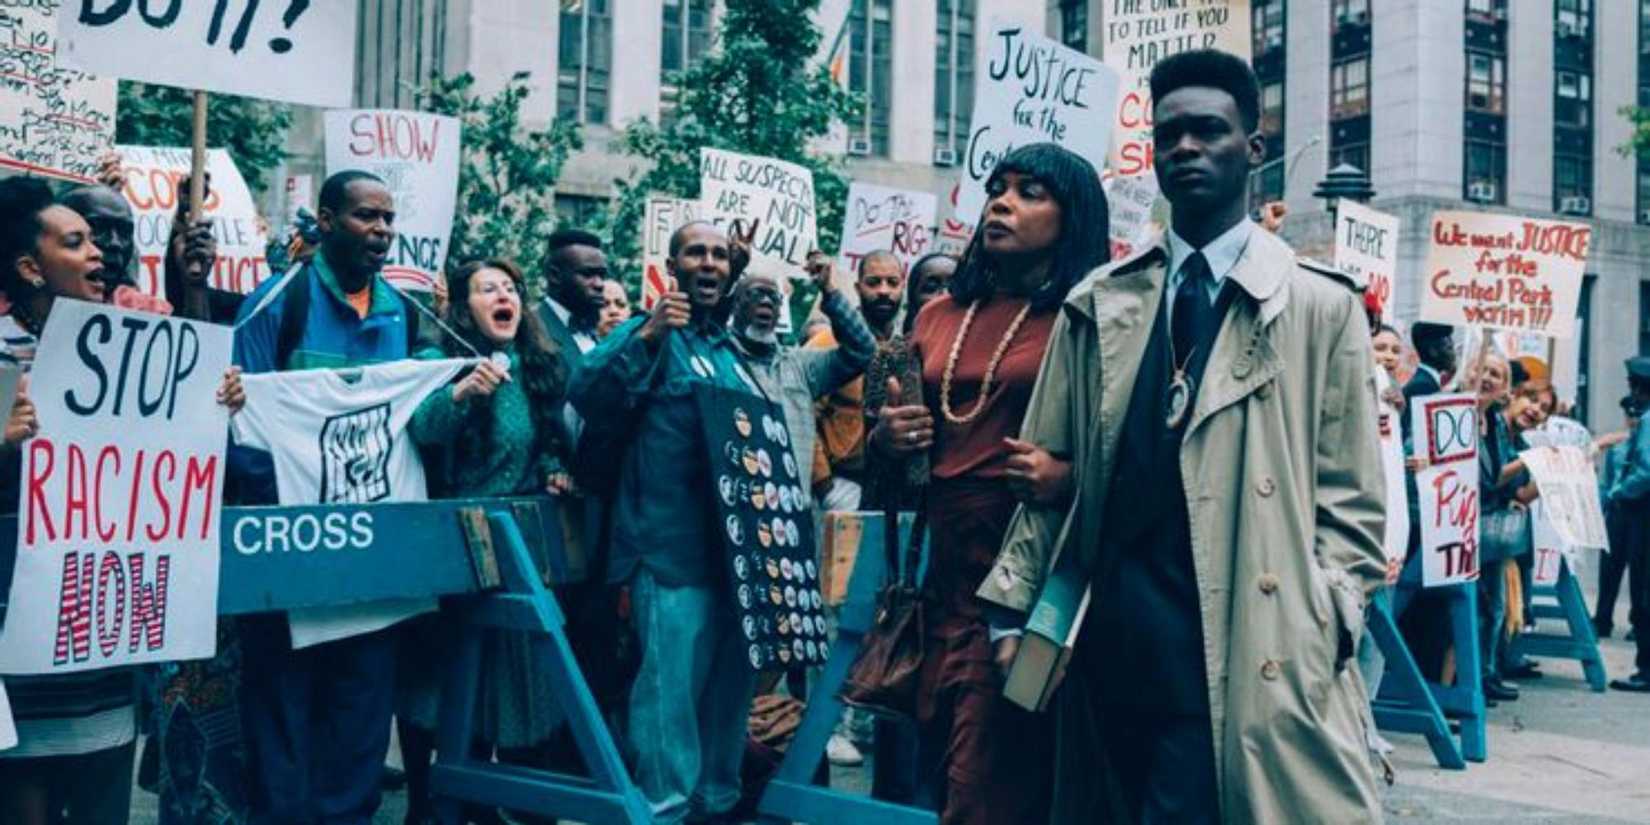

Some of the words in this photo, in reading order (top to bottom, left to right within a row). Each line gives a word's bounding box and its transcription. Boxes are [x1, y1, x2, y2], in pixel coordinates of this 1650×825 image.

[1109, 21, 1130, 43] TO
[1137, 18, 1167, 39] TELL
[1174, 12, 1192, 30] IF
[1197, 6, 1229, 28] YOU
[349, 112, 440, 163] SHOW
[702, 155, 727, 181] ALL
[715, 189, 750, 214] ARE
[766, 198, 812, 233] NOT
[384, 233, 441, 271] NCE
[1434, 221, 1468, 247] We
[1471, 231, 1515, 249] want
[1516, 222, 1592, 261] JUSTICE
[1475, 250, 1502, 274] for
[1505, 253, 1537, 278] the
[1431, 269, 1503, 302] Central
[1508, 277, 1553, 306] Park
[64, 313, 199, 420] STOP
[1435, 408, 1476, 455] DO
[25, 438, 217, 546] RACISM
[233, 511, 374, 555] CROSS
[53, 550, 170, 666] NOW
